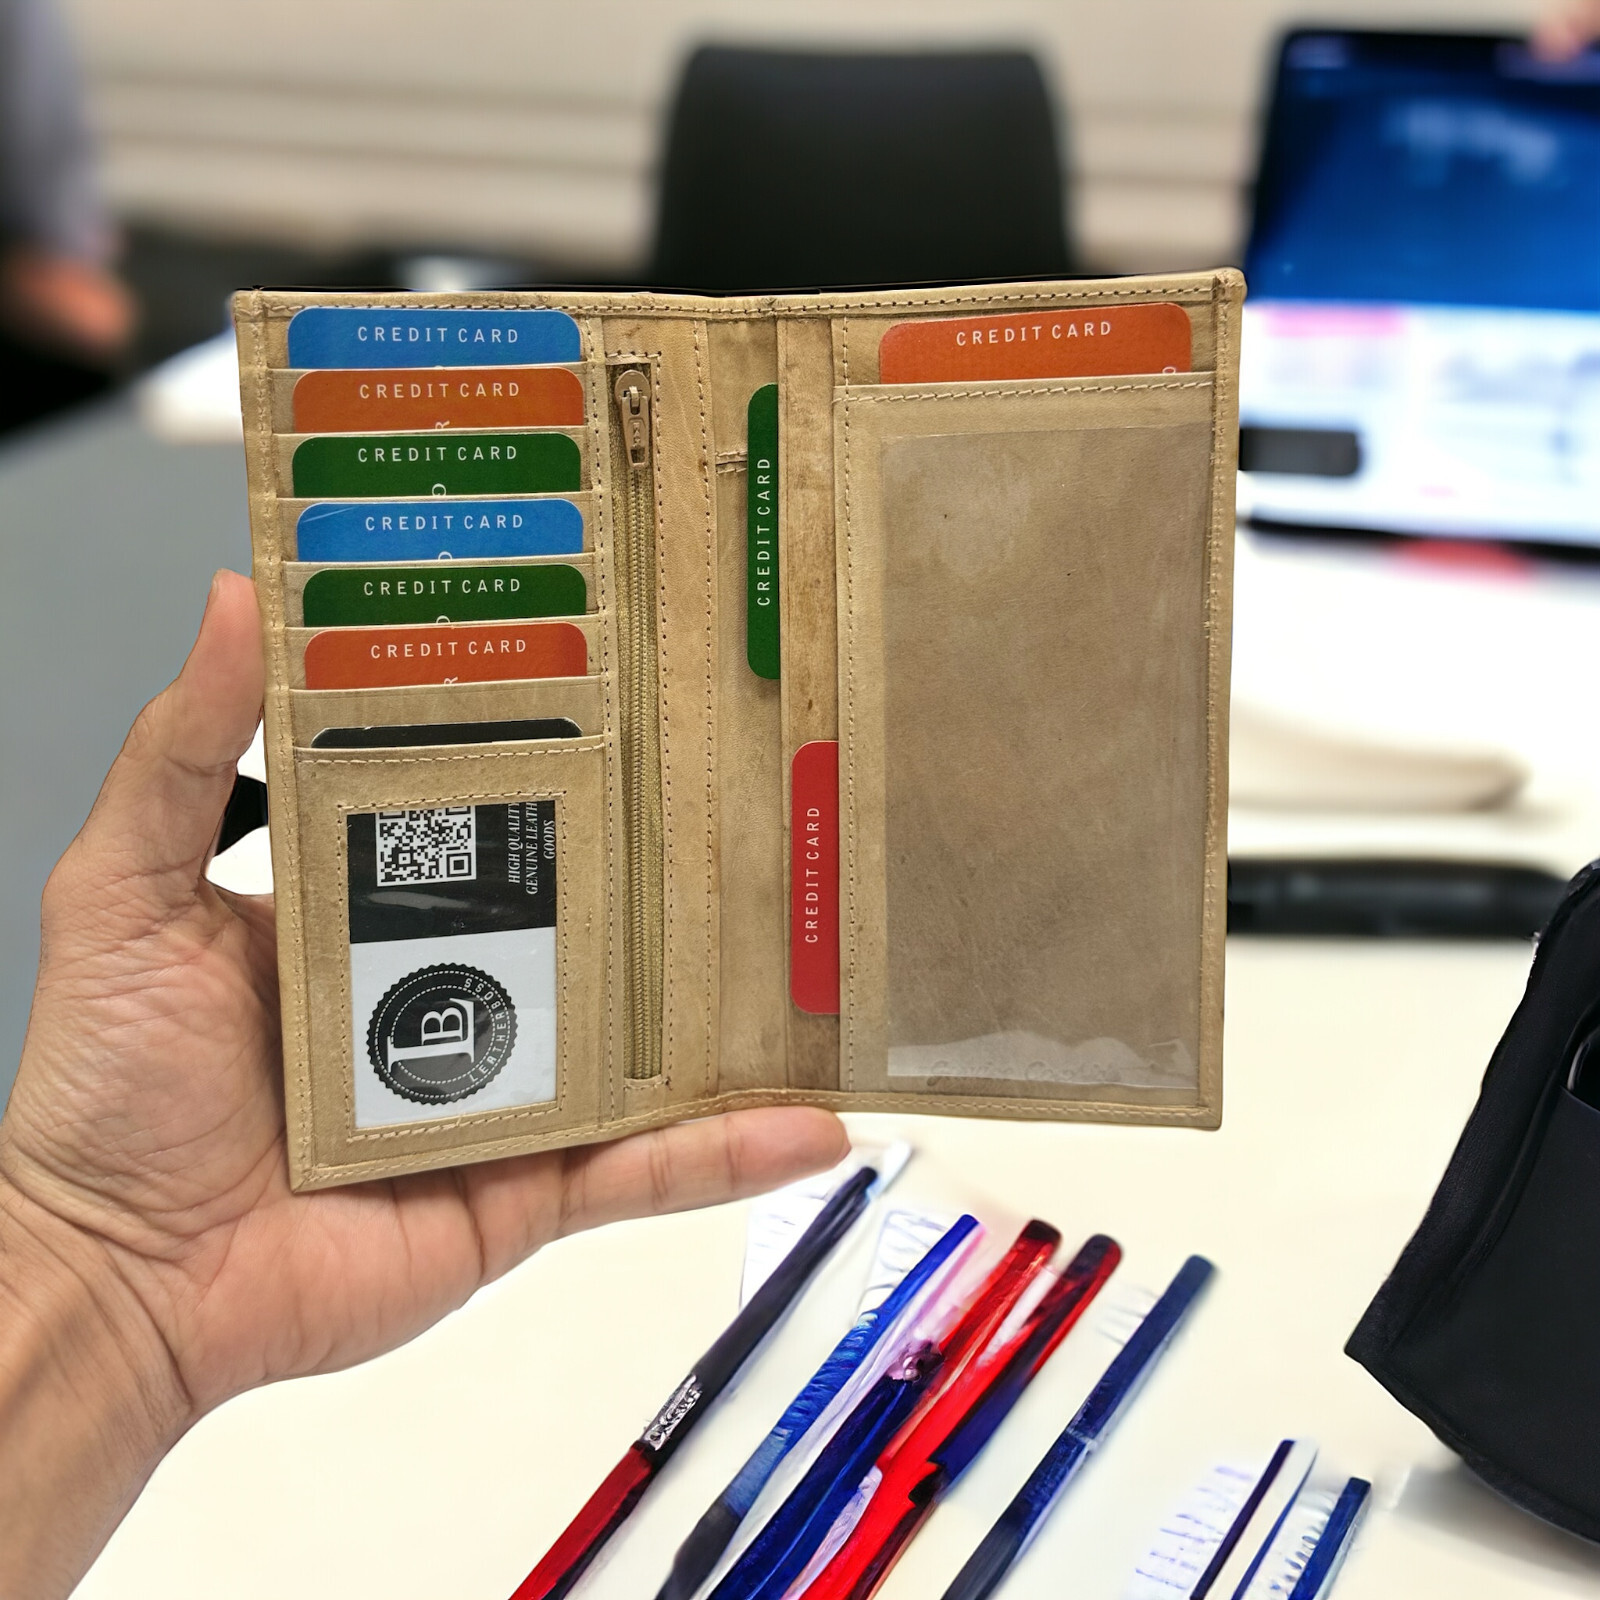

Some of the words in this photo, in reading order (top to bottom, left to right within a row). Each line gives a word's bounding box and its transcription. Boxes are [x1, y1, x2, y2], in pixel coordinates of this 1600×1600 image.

[358, 326, 448, 343] CREDIT
[458, 328, 518, 343] CARD
[956, 326, 1042, 346] CREDIT
[1052, 321, 1111, 339] CARD
[360, 383, 450, 399] CREDIT
[460, 382, 519, 397] CARD
[358, 447, 447, 463] CREDIT
[457, 445, 517, 461] CARD
[757, 459, 771, 516] CARD
[365, 515, 453, 531] CREDIT
[464, 514, 523, 530] CARD
[757, 525, 770, 607] CREDIT
[364, 580, 452, 596] CREDIT
[462, 578, 520, 594] CARD
[370, 642, 458, 659] CREDIT
[468, 639, 526, 655] CARD
[508, 802, 524, 851] QUALITY
[525, 802, 538, 840] LEATH
[543, 820, 556, 859] GOODS
[806, 808, 820, 860] CARD
[508, 853, 521, 884] HIGH
[525, 842, 538, 895] GENUINE
[805, 868, 819, 944] CREDIT
[464, 978, 507, 1082] LEATHERBOSS
